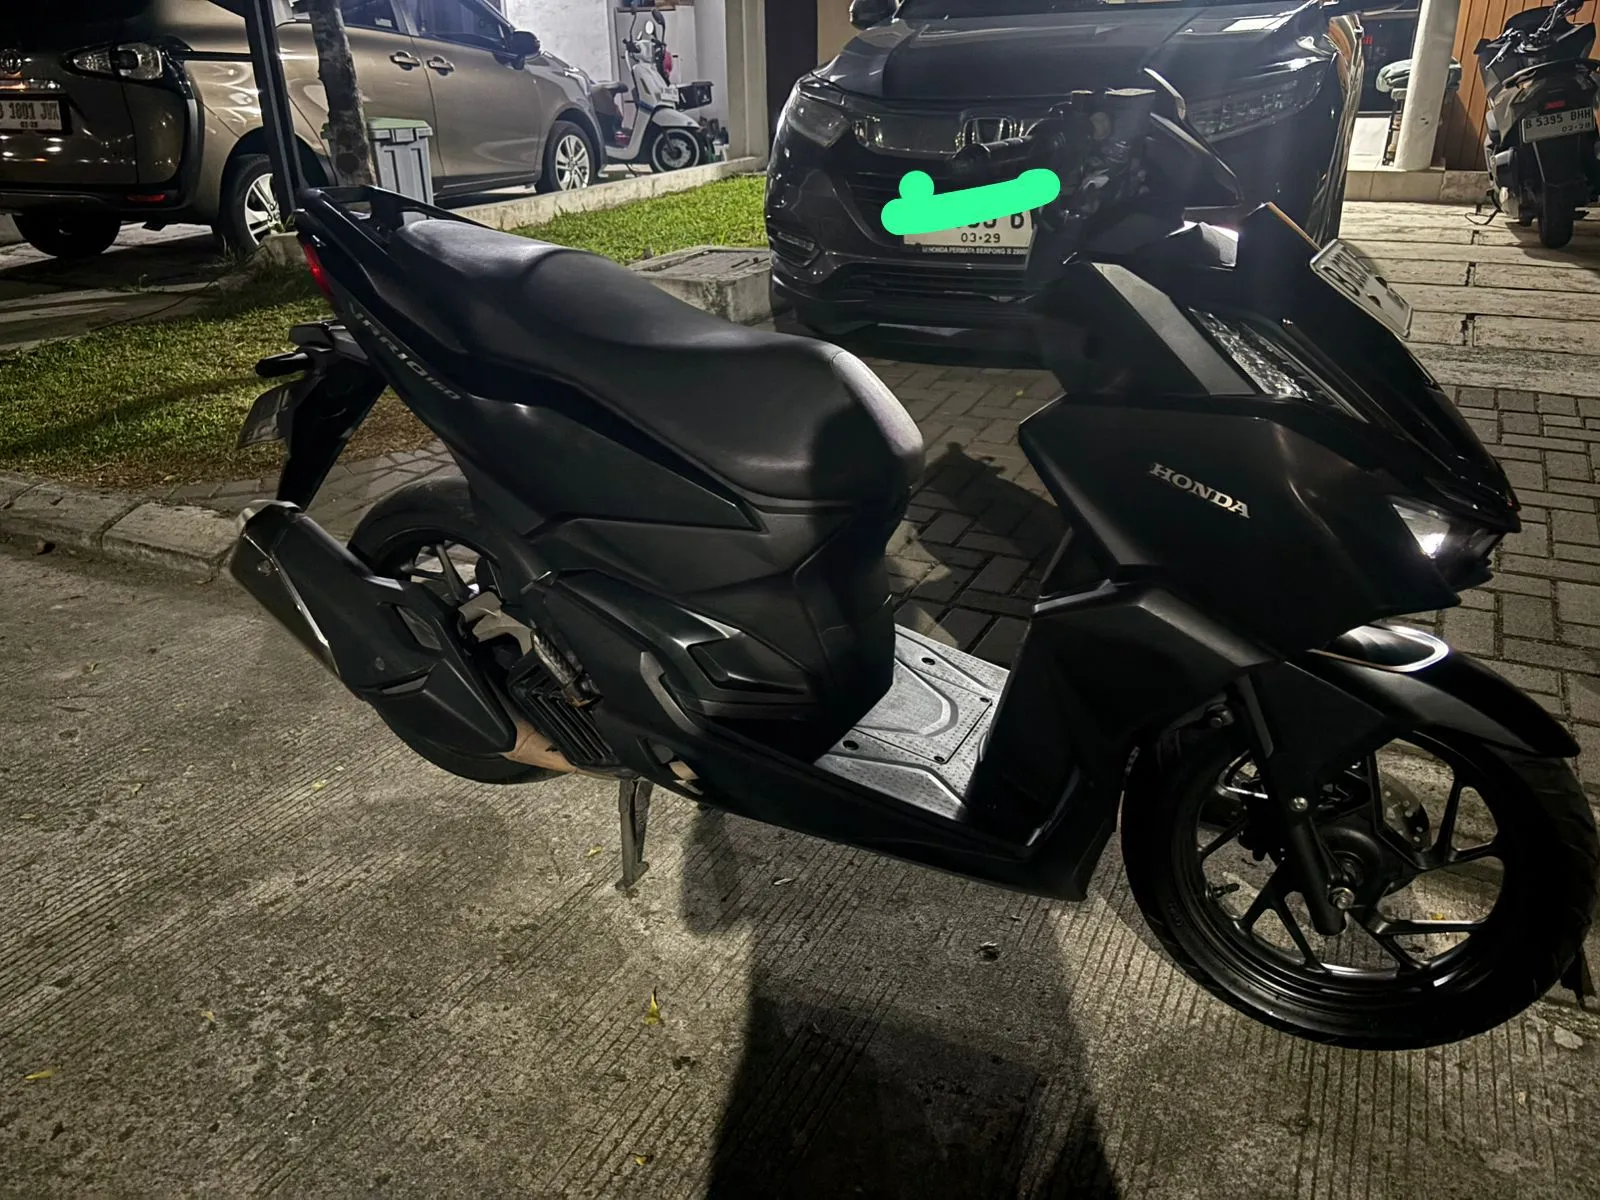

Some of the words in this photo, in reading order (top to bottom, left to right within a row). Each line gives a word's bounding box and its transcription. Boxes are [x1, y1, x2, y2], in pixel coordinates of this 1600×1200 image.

[1536, 114, 1563, 127] 5395
[1570, 109, 1590, 121] BHH
[1149, 462, 1250, 519] HONDA
